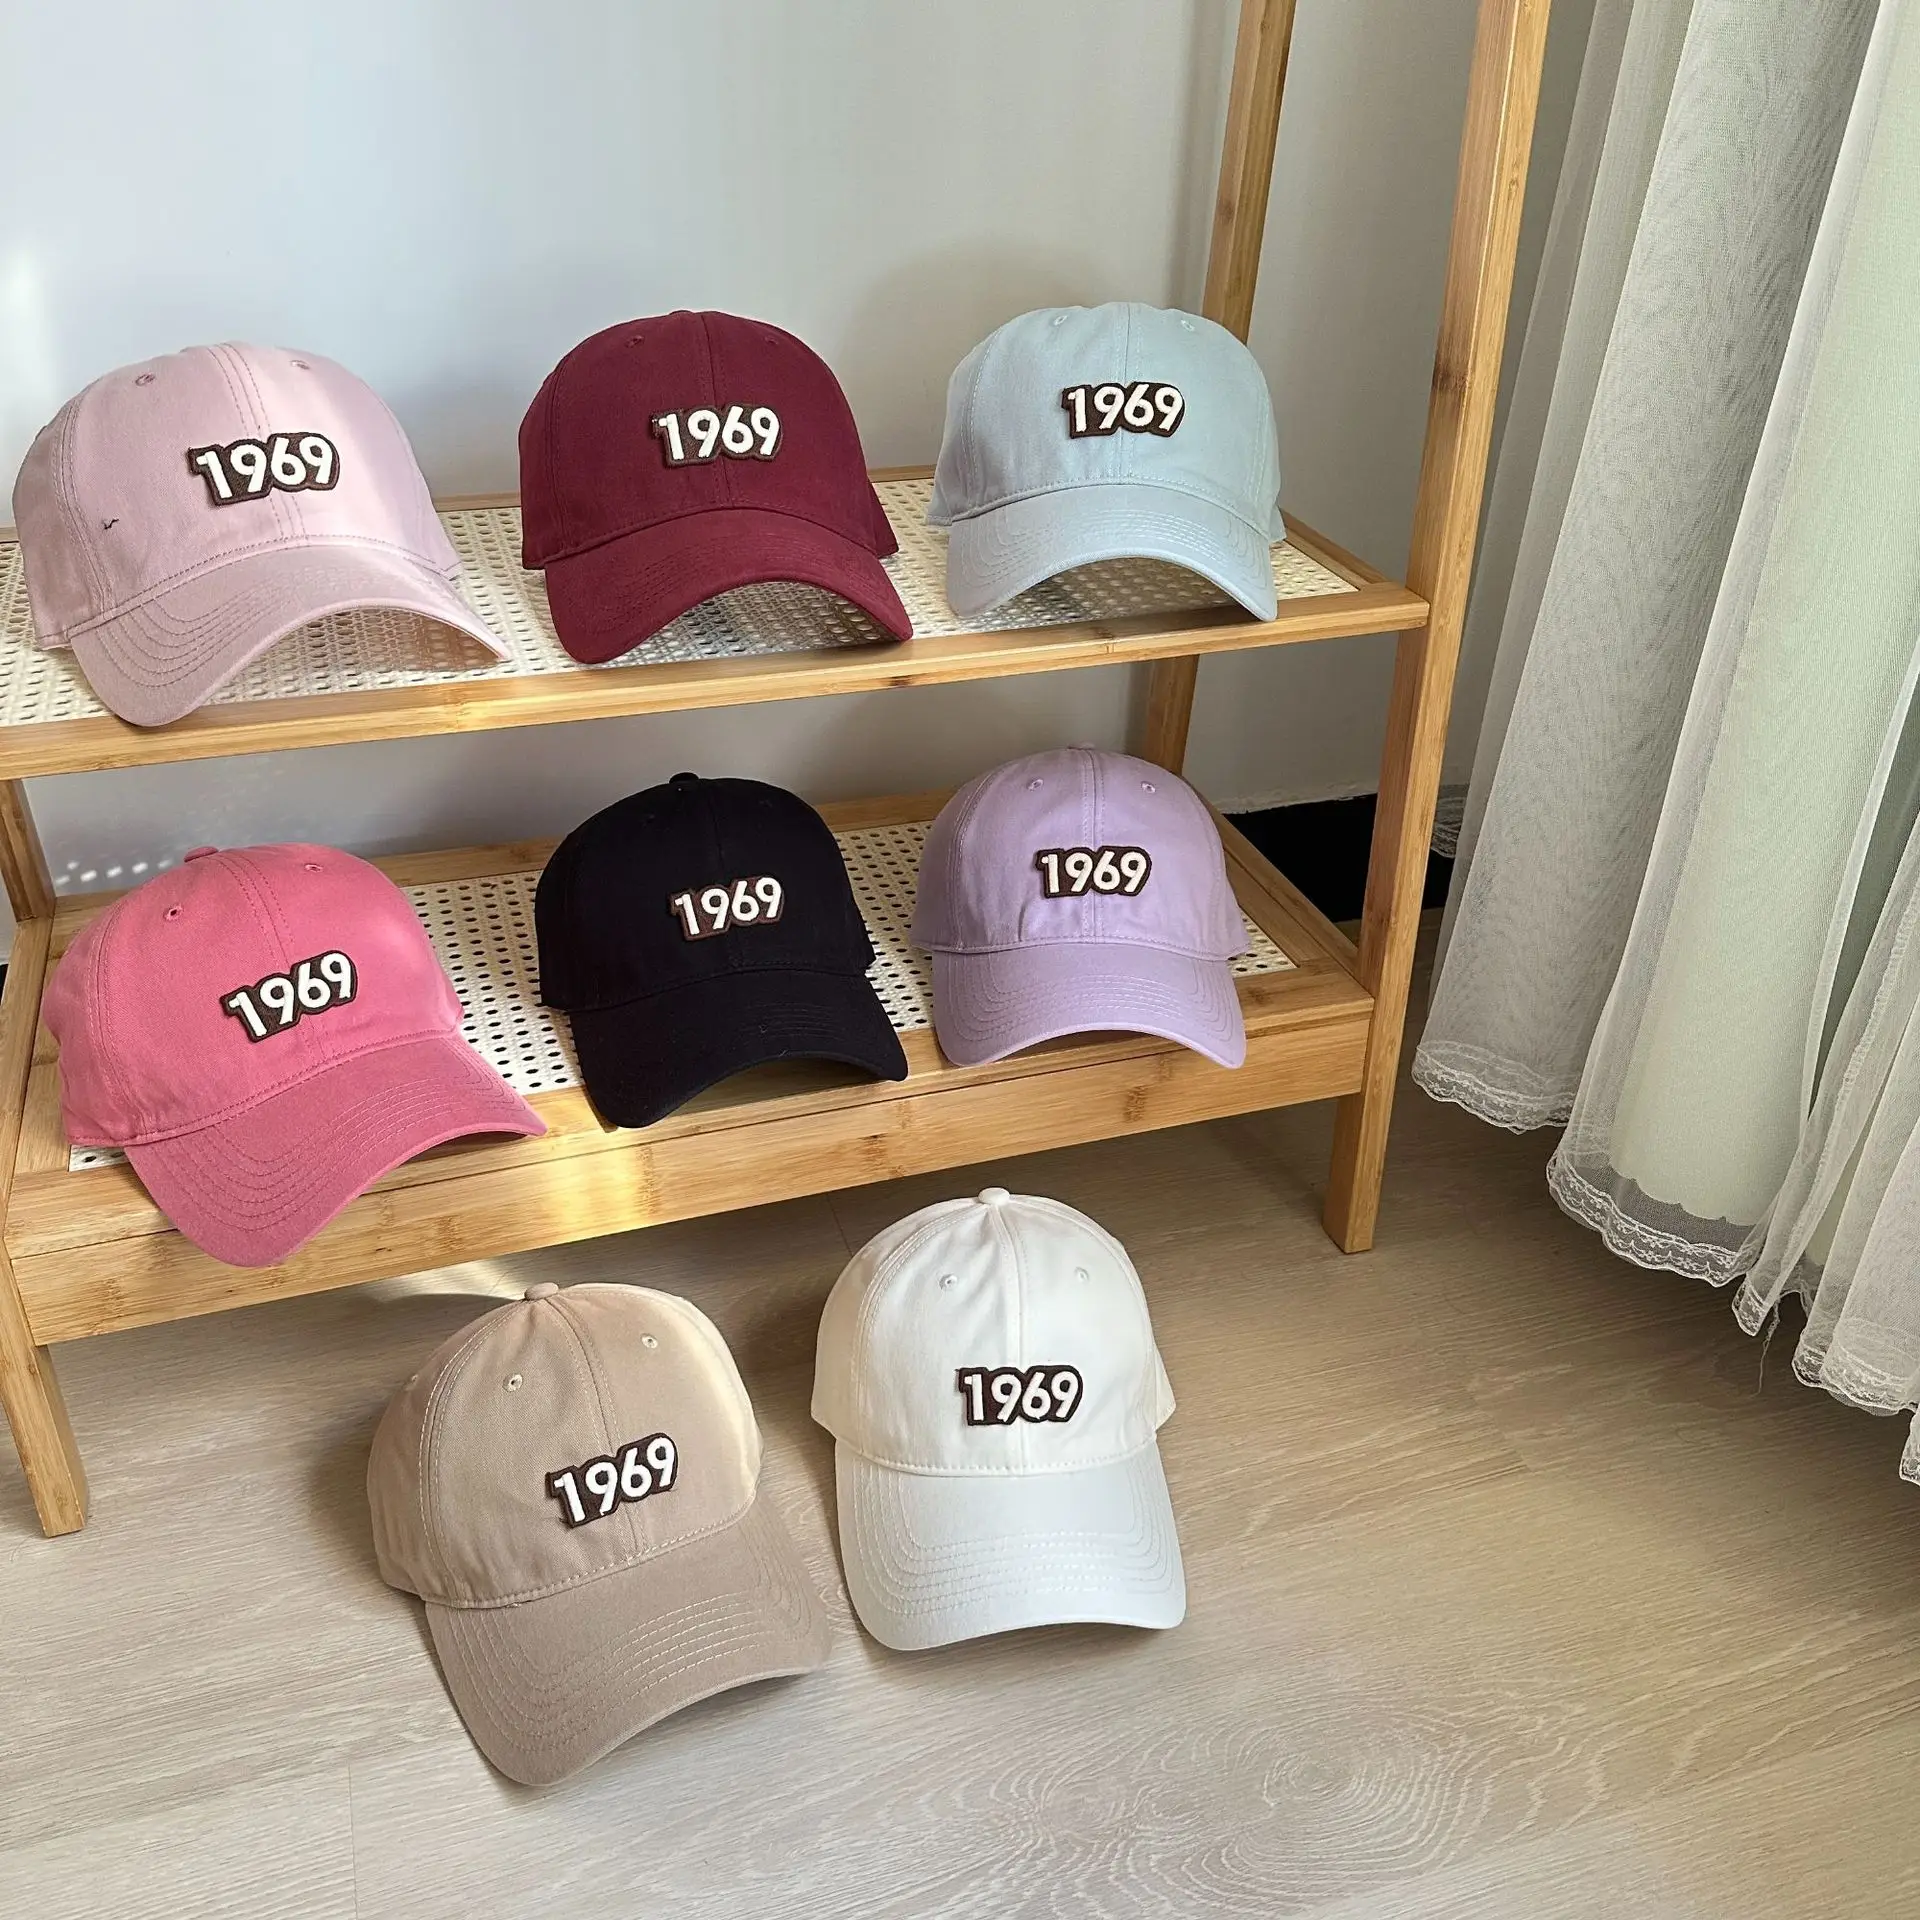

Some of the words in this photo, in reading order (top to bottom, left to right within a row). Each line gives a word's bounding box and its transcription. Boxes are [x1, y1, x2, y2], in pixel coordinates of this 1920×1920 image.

[658, 404, 781, 461] 1969
[1067, 383, 1183, 433] 1969
[195, 435, 334, 500] 1969
[1041, 849, 1148, 894] 1969
[674, 876, 783, 936] 1969
[228, 951, 352, 1038] 1969
[964, 1370, 1080, 1423] 1969
[553, 1436, 675, 1523] 1969
